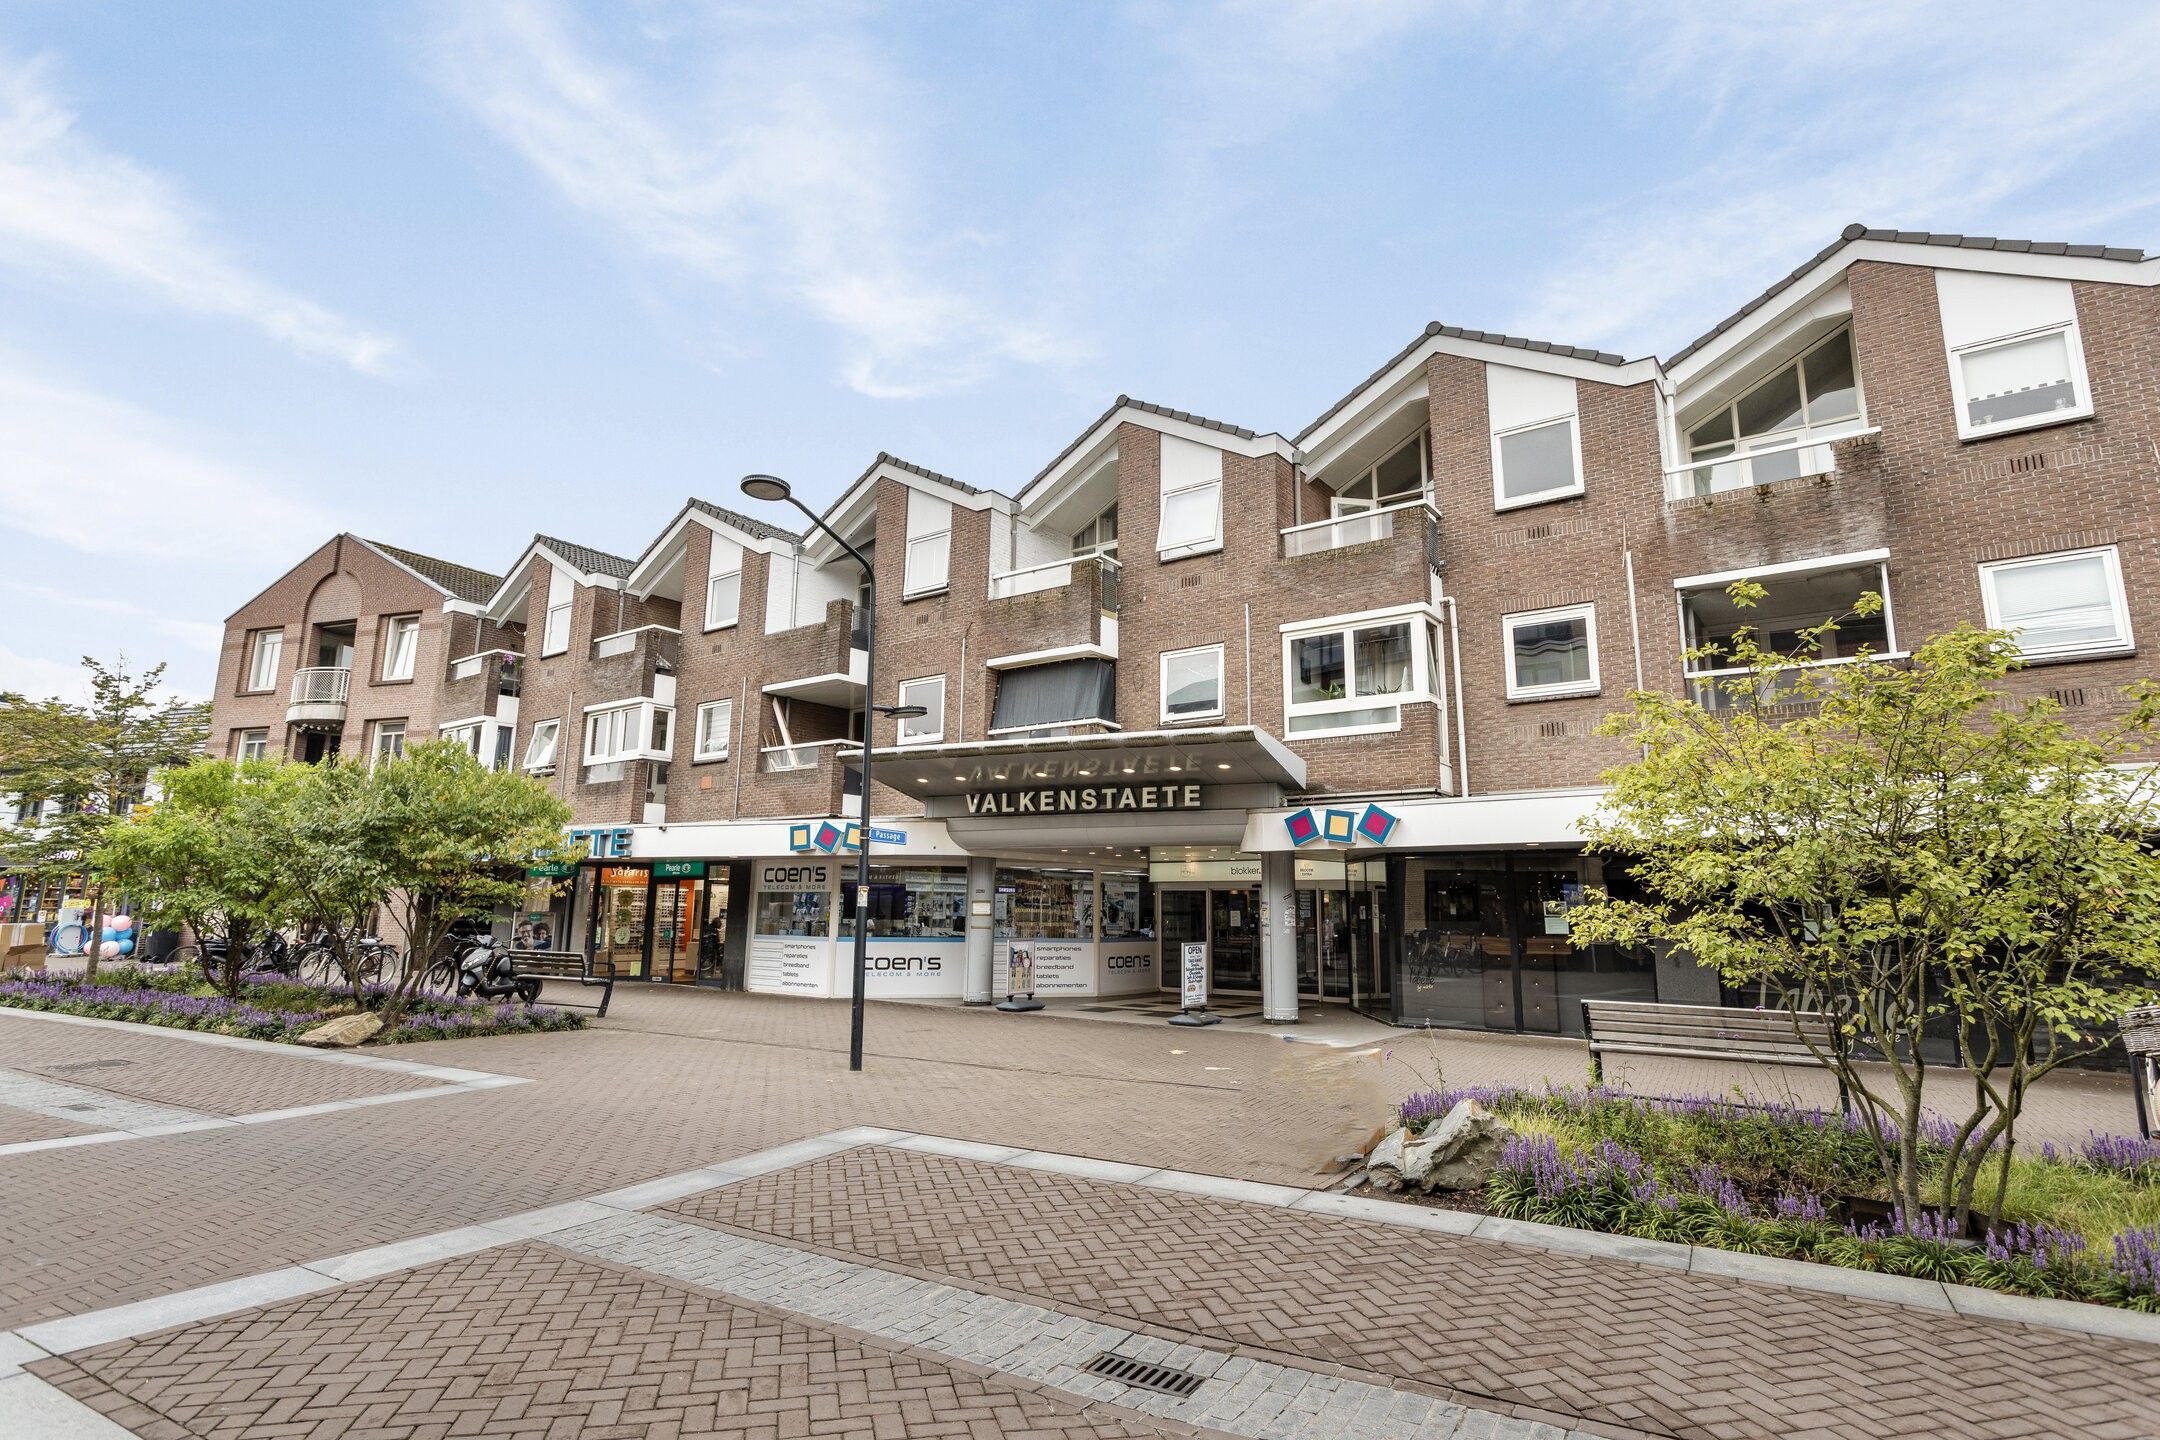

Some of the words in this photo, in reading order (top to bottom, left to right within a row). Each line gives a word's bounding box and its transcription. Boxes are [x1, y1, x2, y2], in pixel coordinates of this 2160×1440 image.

[965, 784, 1201, 813] VALKENSTAETE
[875, 830, 901, 841] Passage
[665, 863, 681, 872] Pearle
[1187, 946, 1203, 955] OPEN
[782, 980, 819, 988] abonnementen
